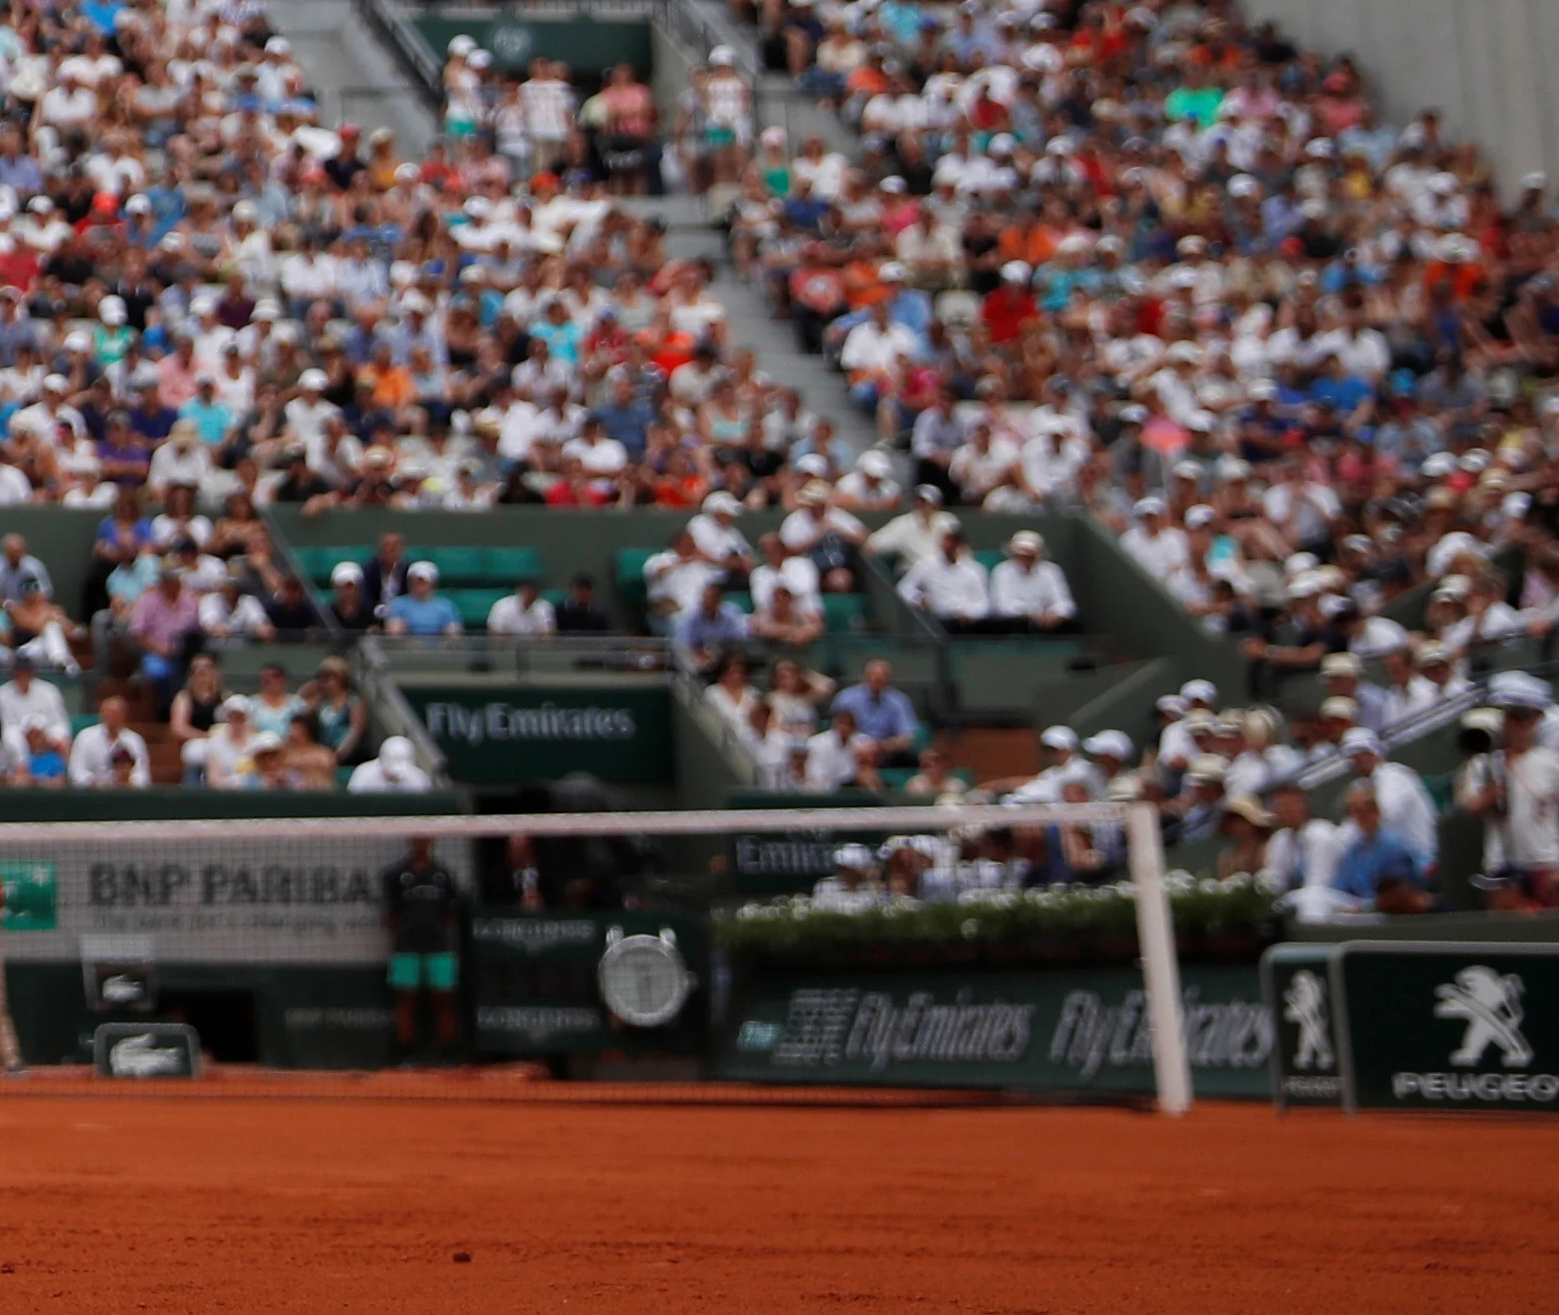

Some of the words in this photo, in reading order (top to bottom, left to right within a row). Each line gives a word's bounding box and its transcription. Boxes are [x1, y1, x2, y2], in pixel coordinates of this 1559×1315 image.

[426, 702, 485, 745] Fly
[485, 700, 636, 741] Emirates
[88, 861, 186, 906] BNP
[201, 863, 383, 906] PARIBA
[893, 986, 1037, 1062] Emirates
